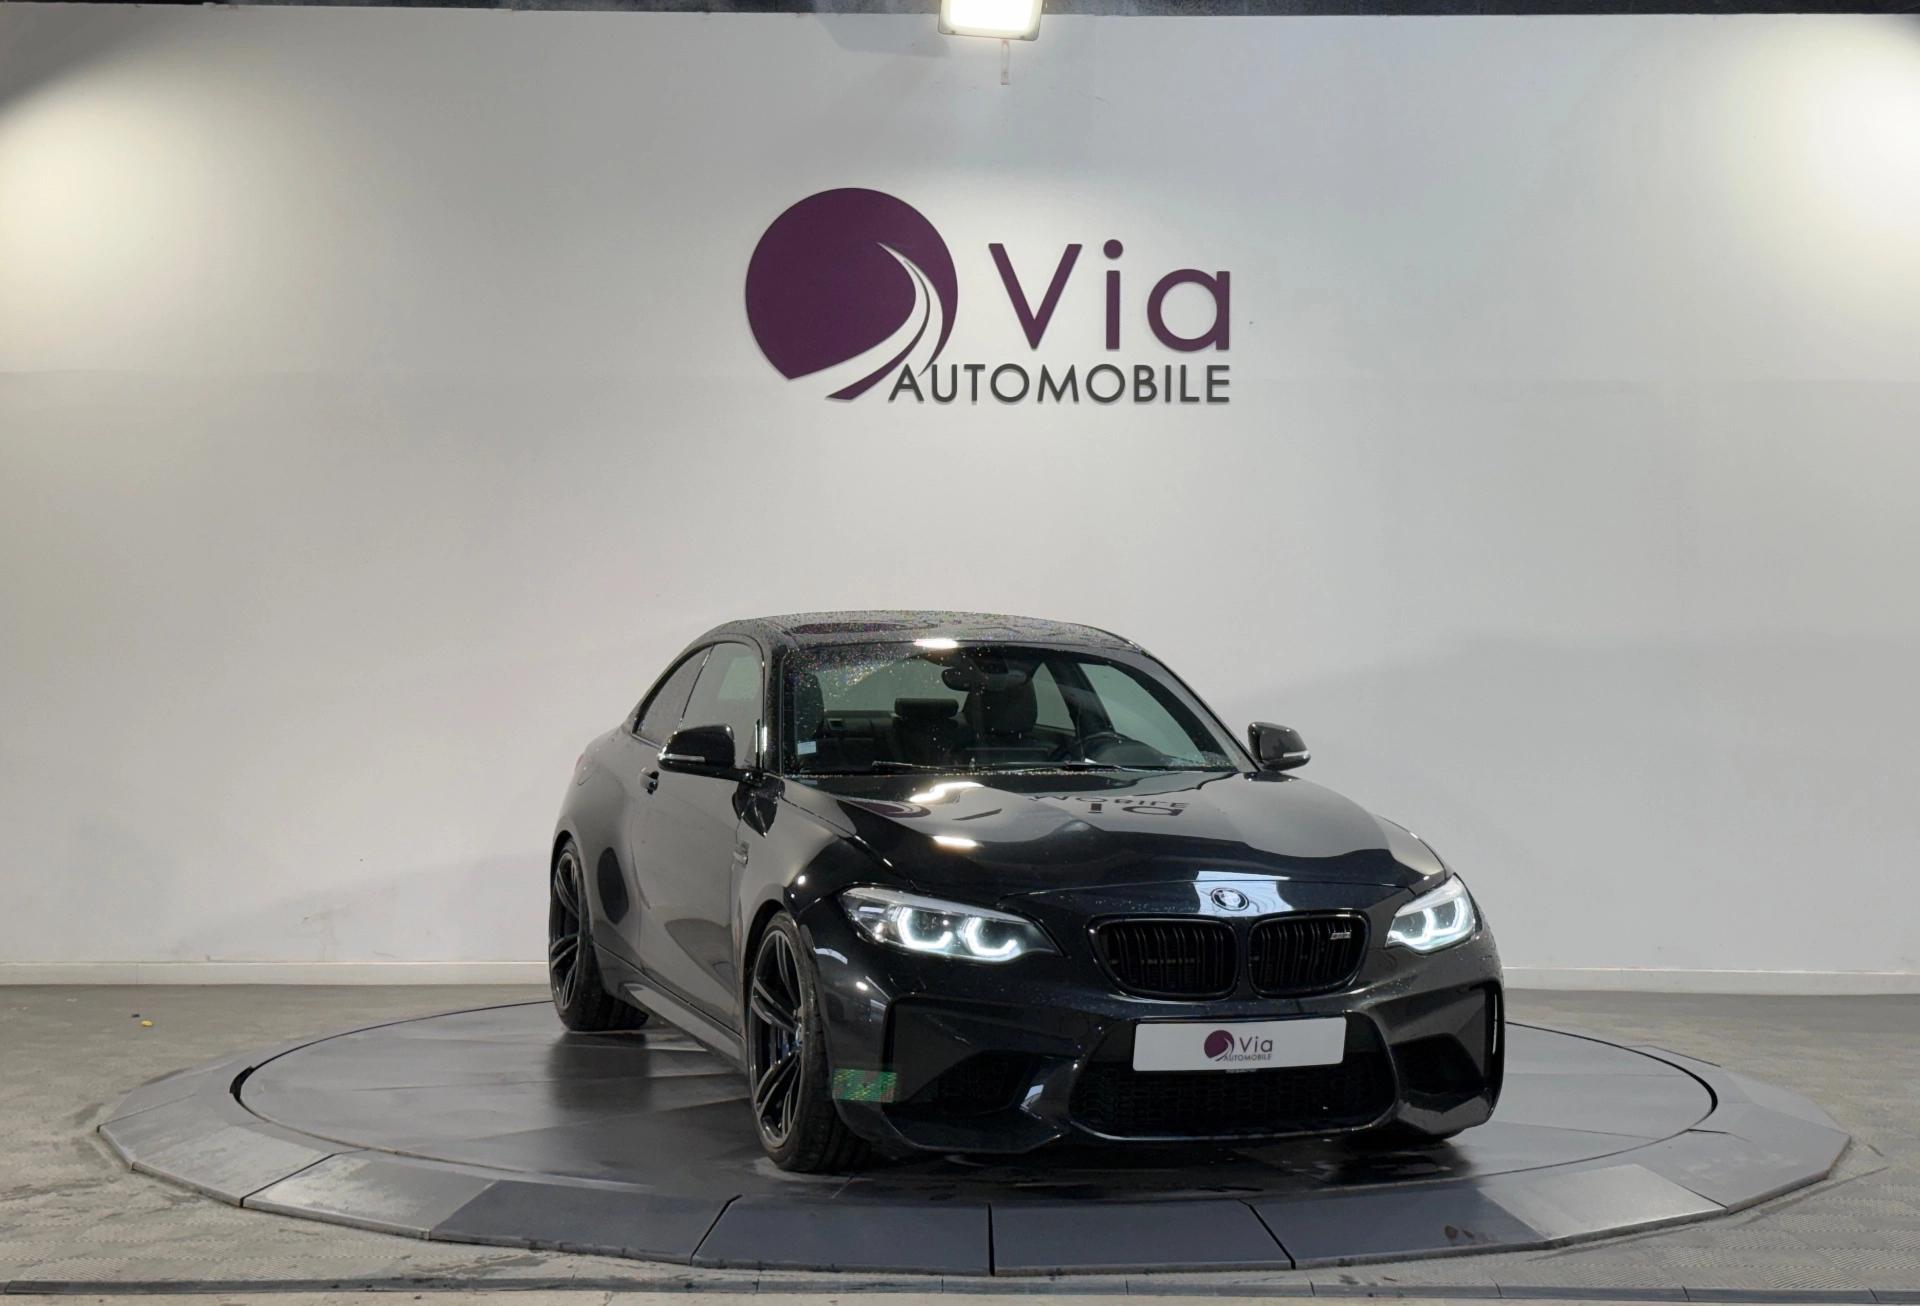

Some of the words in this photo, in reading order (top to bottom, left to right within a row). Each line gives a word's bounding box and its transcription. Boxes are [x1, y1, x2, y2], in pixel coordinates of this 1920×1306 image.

[988, 239, 1231, 352] Via
[887, 363, 1231, 403] AUTOMOBILE
[1239, 1036, 1273, 1053] Via
